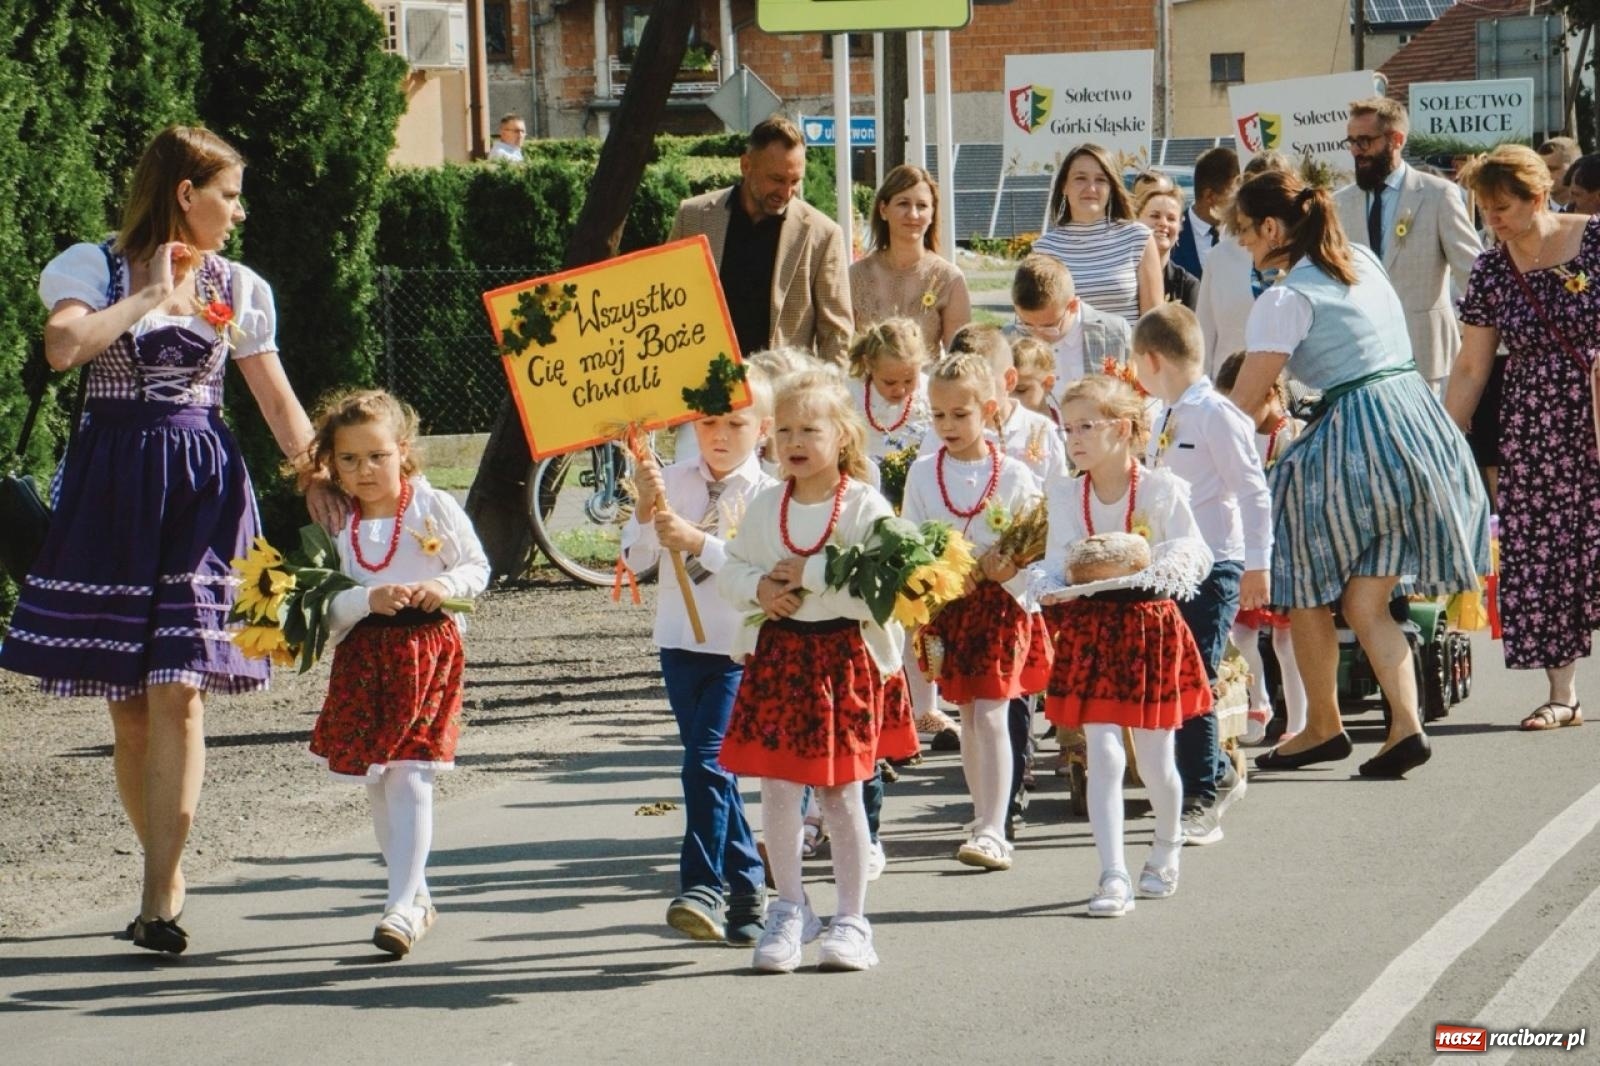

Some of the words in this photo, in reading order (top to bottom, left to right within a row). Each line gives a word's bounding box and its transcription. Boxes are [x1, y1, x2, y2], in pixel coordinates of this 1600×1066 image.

[1065, 87, 1132, 104] Sołectwo
[1419, 92, 1523, 112] SOŁECTWO
[1050, 116, 1092, 135] Górki
[1093, 113, 1146, 136] Śląskie
[1293, 109, 1350, 127] Sołectw
[1429, 113, 1513, 135] BABICE
[1291, 139, 1350, 157] Szymoc
[573, 282, 687, 337] Wszystko
[527, 354, 567, 387] Cię
[579, 338, 625, 376] mój
[635, 322, 706, 360] Boże
[572, 365, 661, 407] chwali
